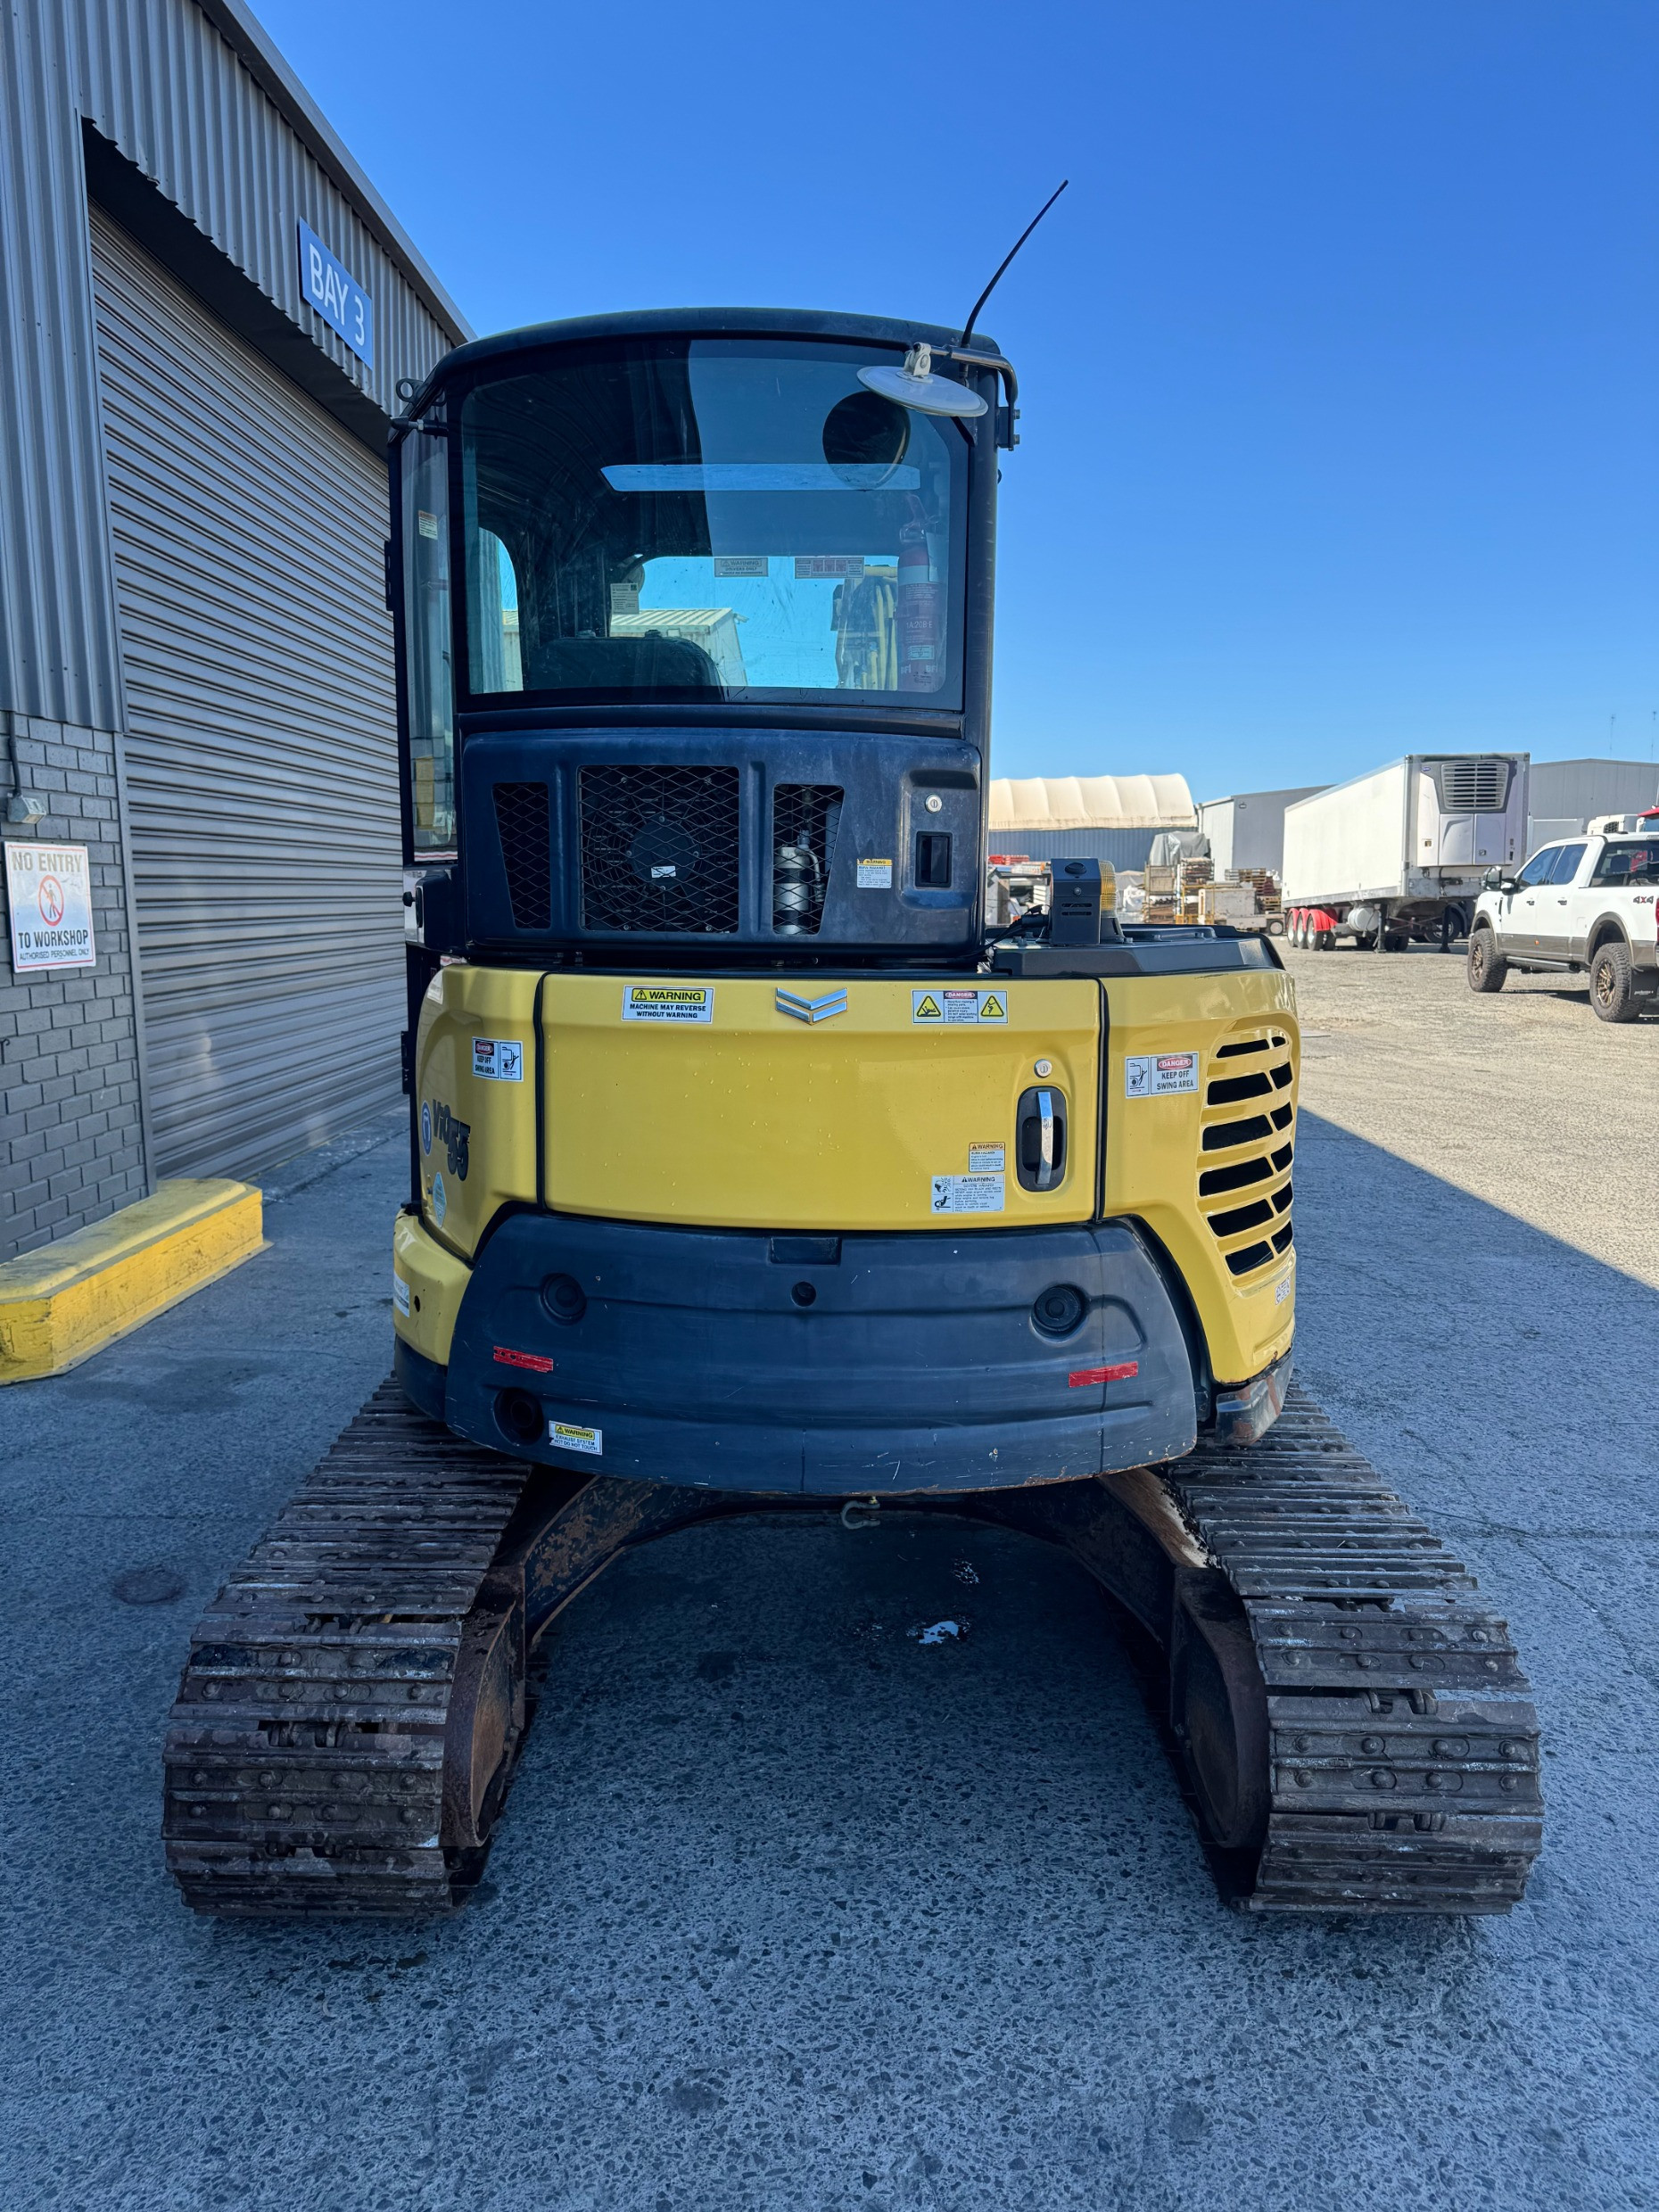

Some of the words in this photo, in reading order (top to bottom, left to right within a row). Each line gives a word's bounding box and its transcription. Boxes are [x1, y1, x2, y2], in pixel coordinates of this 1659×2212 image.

[310, 243, 348, 326] BAY
[355, 295, 365, 346] 3
[12, 852, 33, 871] NO
[38, 853, 83, 872] ENTRY
[18, 932, 31, 948] TO
[34, 929, 88, 947] WORKSHOP
[20, 951, 50, 961] AUTHORISED
[51, 949, 78, 959] PERSONNEL
[649, 991, 701, 1001] WARNING
[1162, 1059, 1189, 1068] DANGER
[1161, 1071, 1177, 1080] KEEP
[1178, 1070, 1190, 1078] OFF
[1157, 1081, 1177, 1090] SWING
[1178, 1079, 1193, 1088] AREA
[565, 1428, 592, 1438] WARNING
